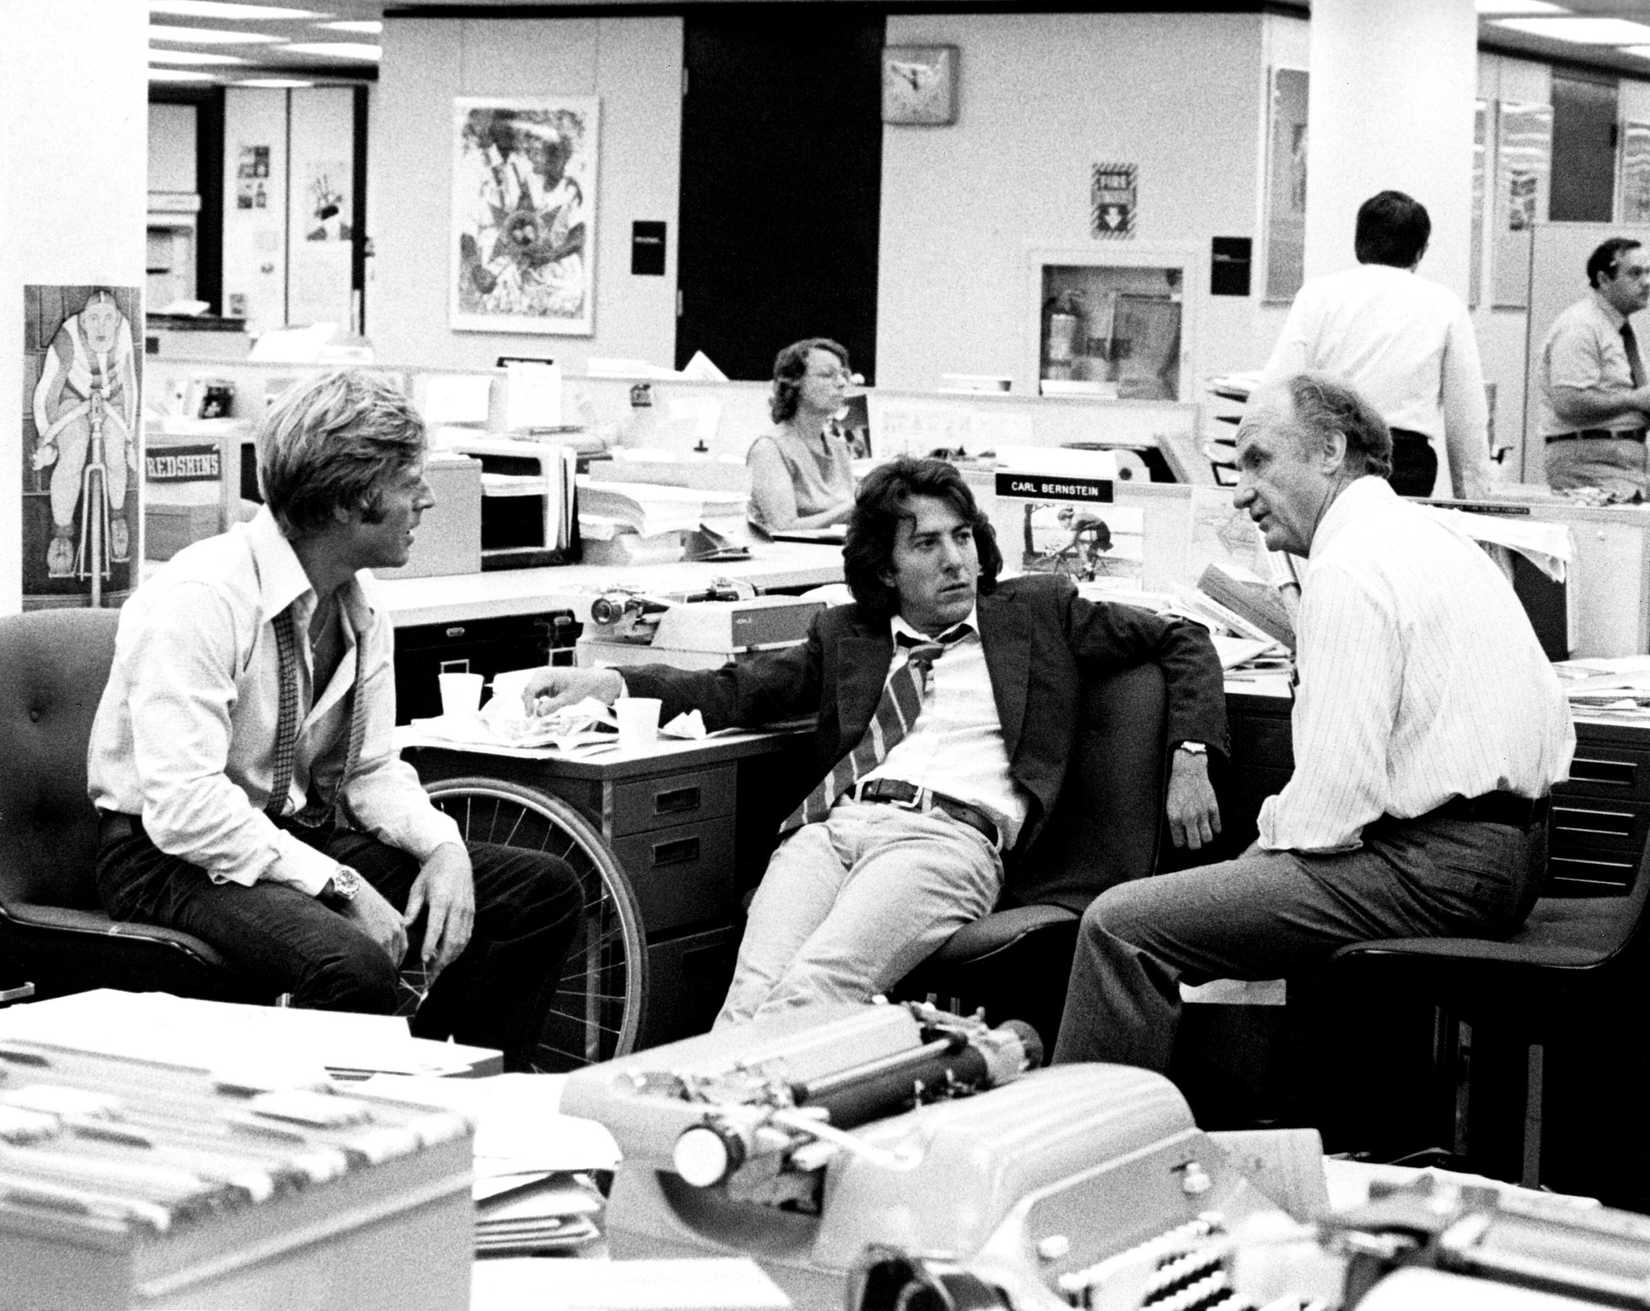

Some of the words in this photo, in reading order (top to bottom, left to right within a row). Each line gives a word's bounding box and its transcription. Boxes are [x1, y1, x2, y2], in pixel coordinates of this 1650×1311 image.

[146, 454, 219, 478] REDSKINS
[1011, 481, 1038, 493] CARL
[1041, 483, 1099, 497] BERNSTEIN
